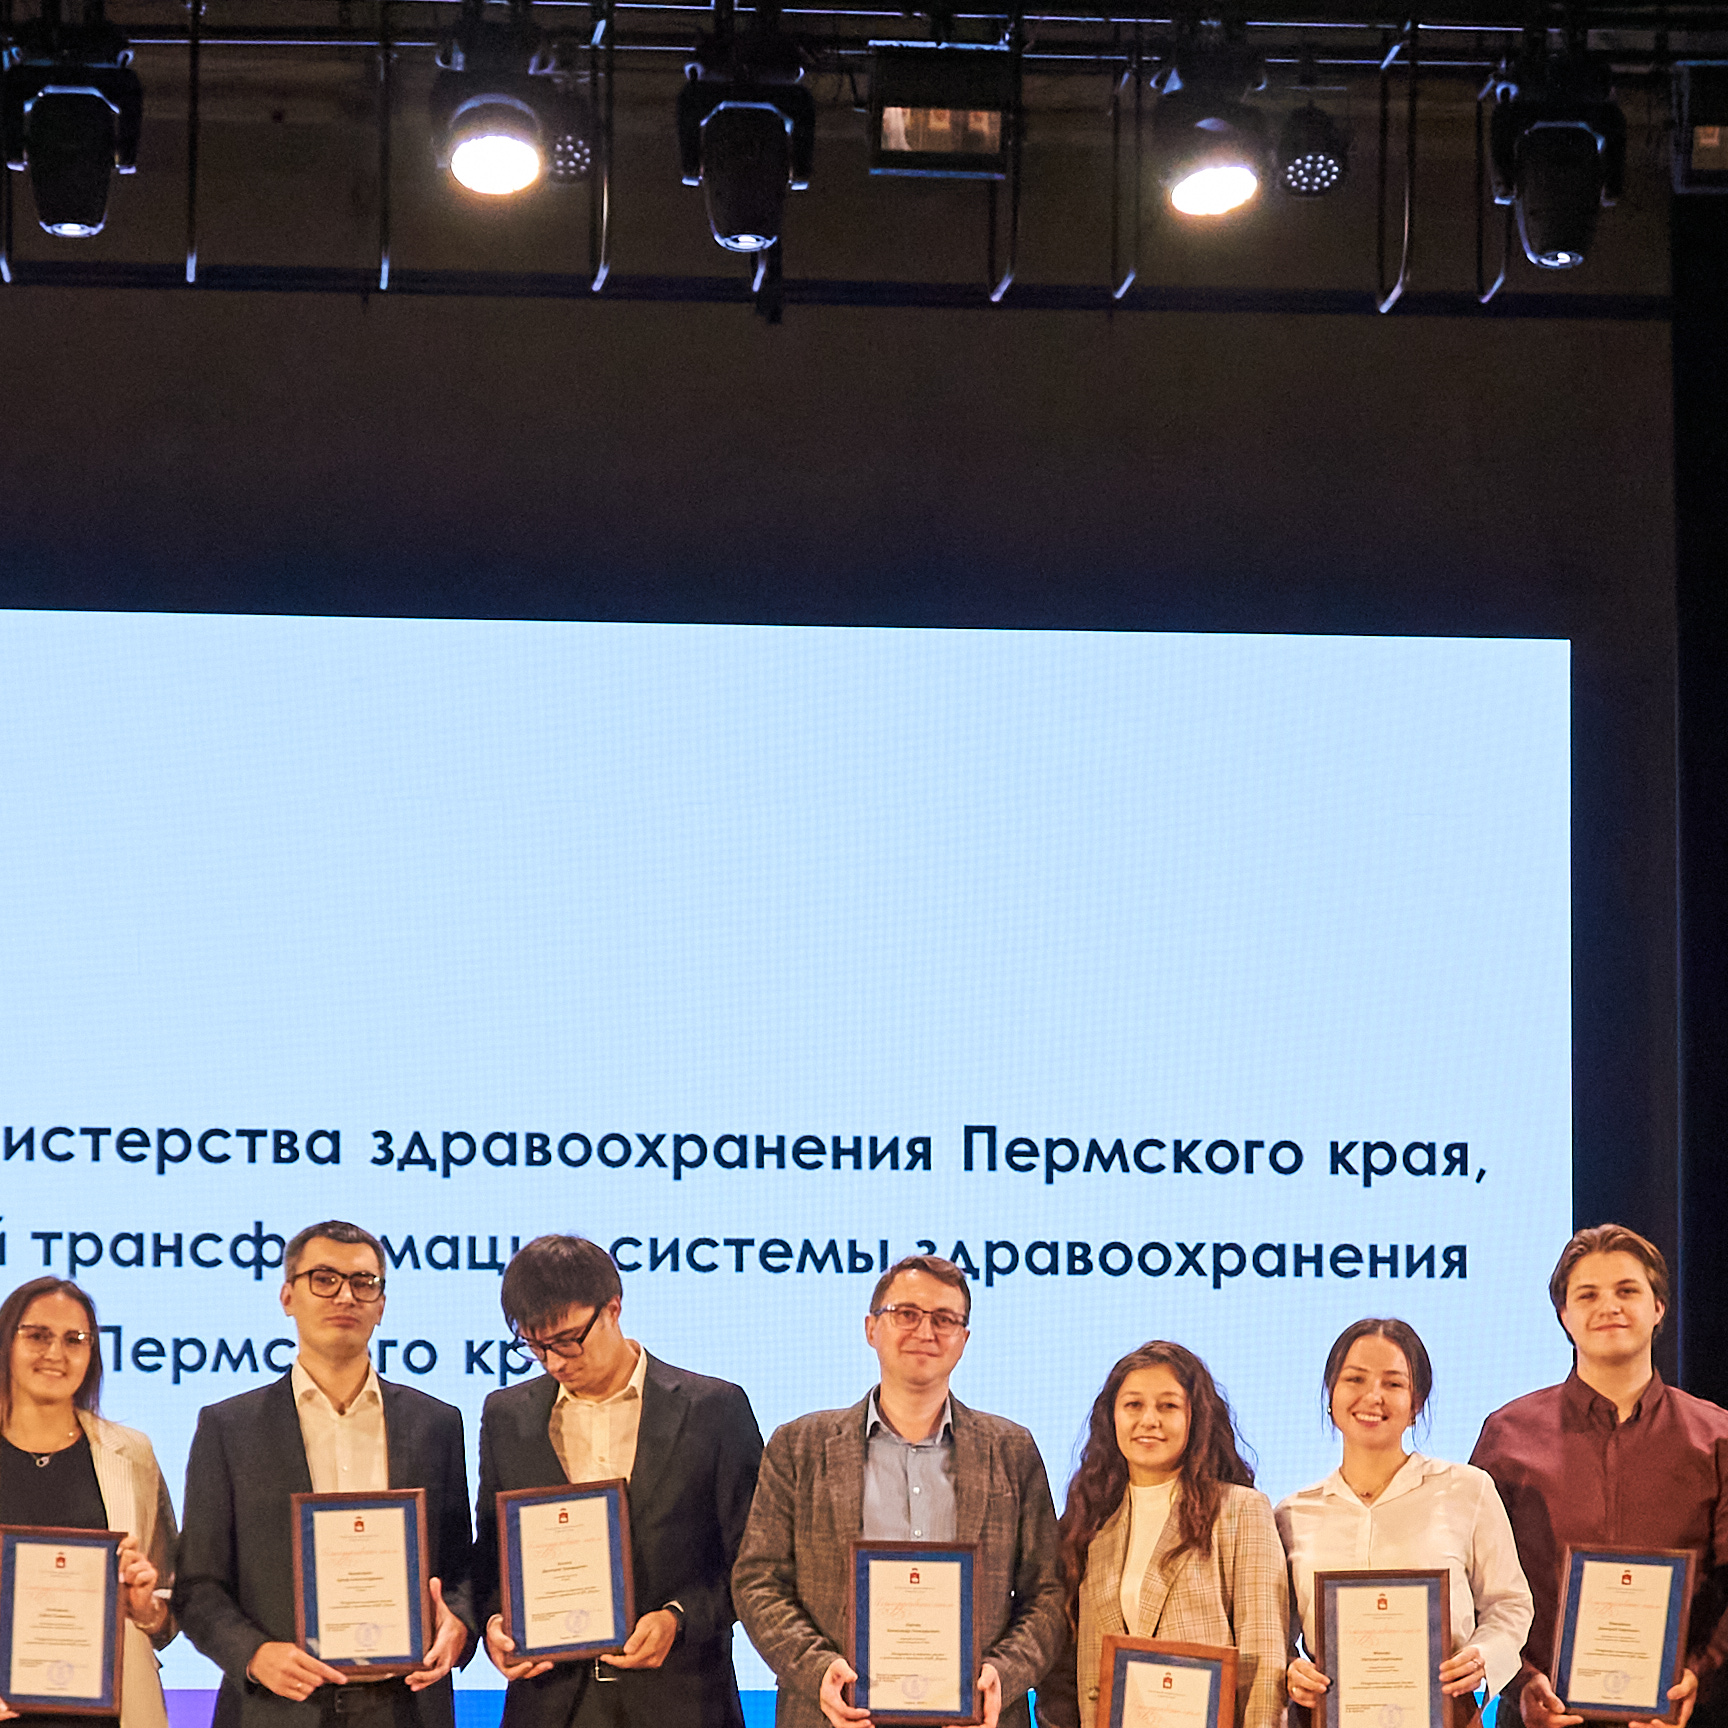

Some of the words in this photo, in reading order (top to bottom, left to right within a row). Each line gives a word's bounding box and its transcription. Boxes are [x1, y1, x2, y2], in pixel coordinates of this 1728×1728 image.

[370, 1129, 932, 1181] здравоохранения
[963, 1124, 1304, 1185] Пермского
[1329, 1140, 1487, 1189] края,
[29, 1220, 520, 1282] трансфмац
[610, 1236, 890, 1274] системы
[99, 1325, 438, 1385] Пермсго
